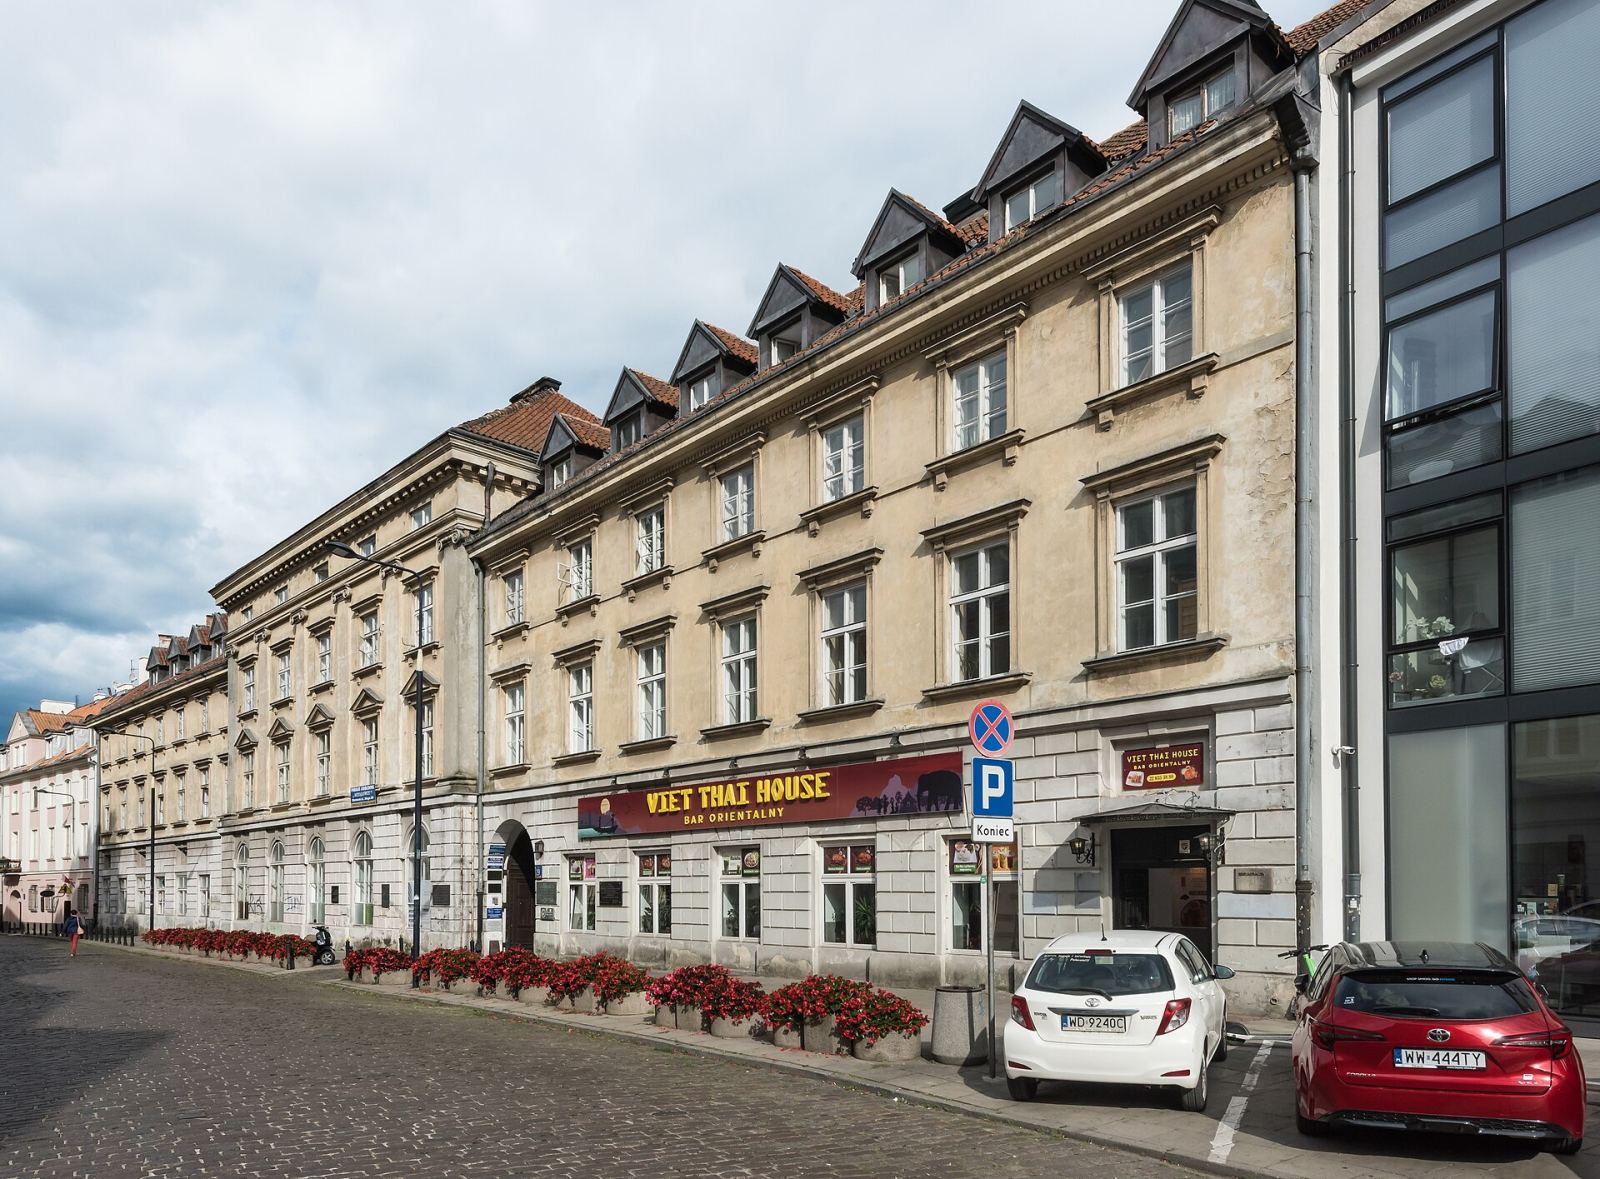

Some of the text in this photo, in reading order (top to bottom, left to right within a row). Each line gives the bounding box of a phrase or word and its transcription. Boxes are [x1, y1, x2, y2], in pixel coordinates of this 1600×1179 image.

[1127, 749, 1199, 763] VIET THAI HOUSE
[646, 772, 831, 814] VIET THAI HOUSE
[982, 765, 1005, 809] P
[684, 807, 784, 825] BAR ORIENTALNY
[976, 824, 1010, 836] Koniec
[1069, 1017, 1085, 1027] WD
[1088, 1017, 1124, 1029] 9240C
[1405, 1050, 1481, 1067] WW 444TY
